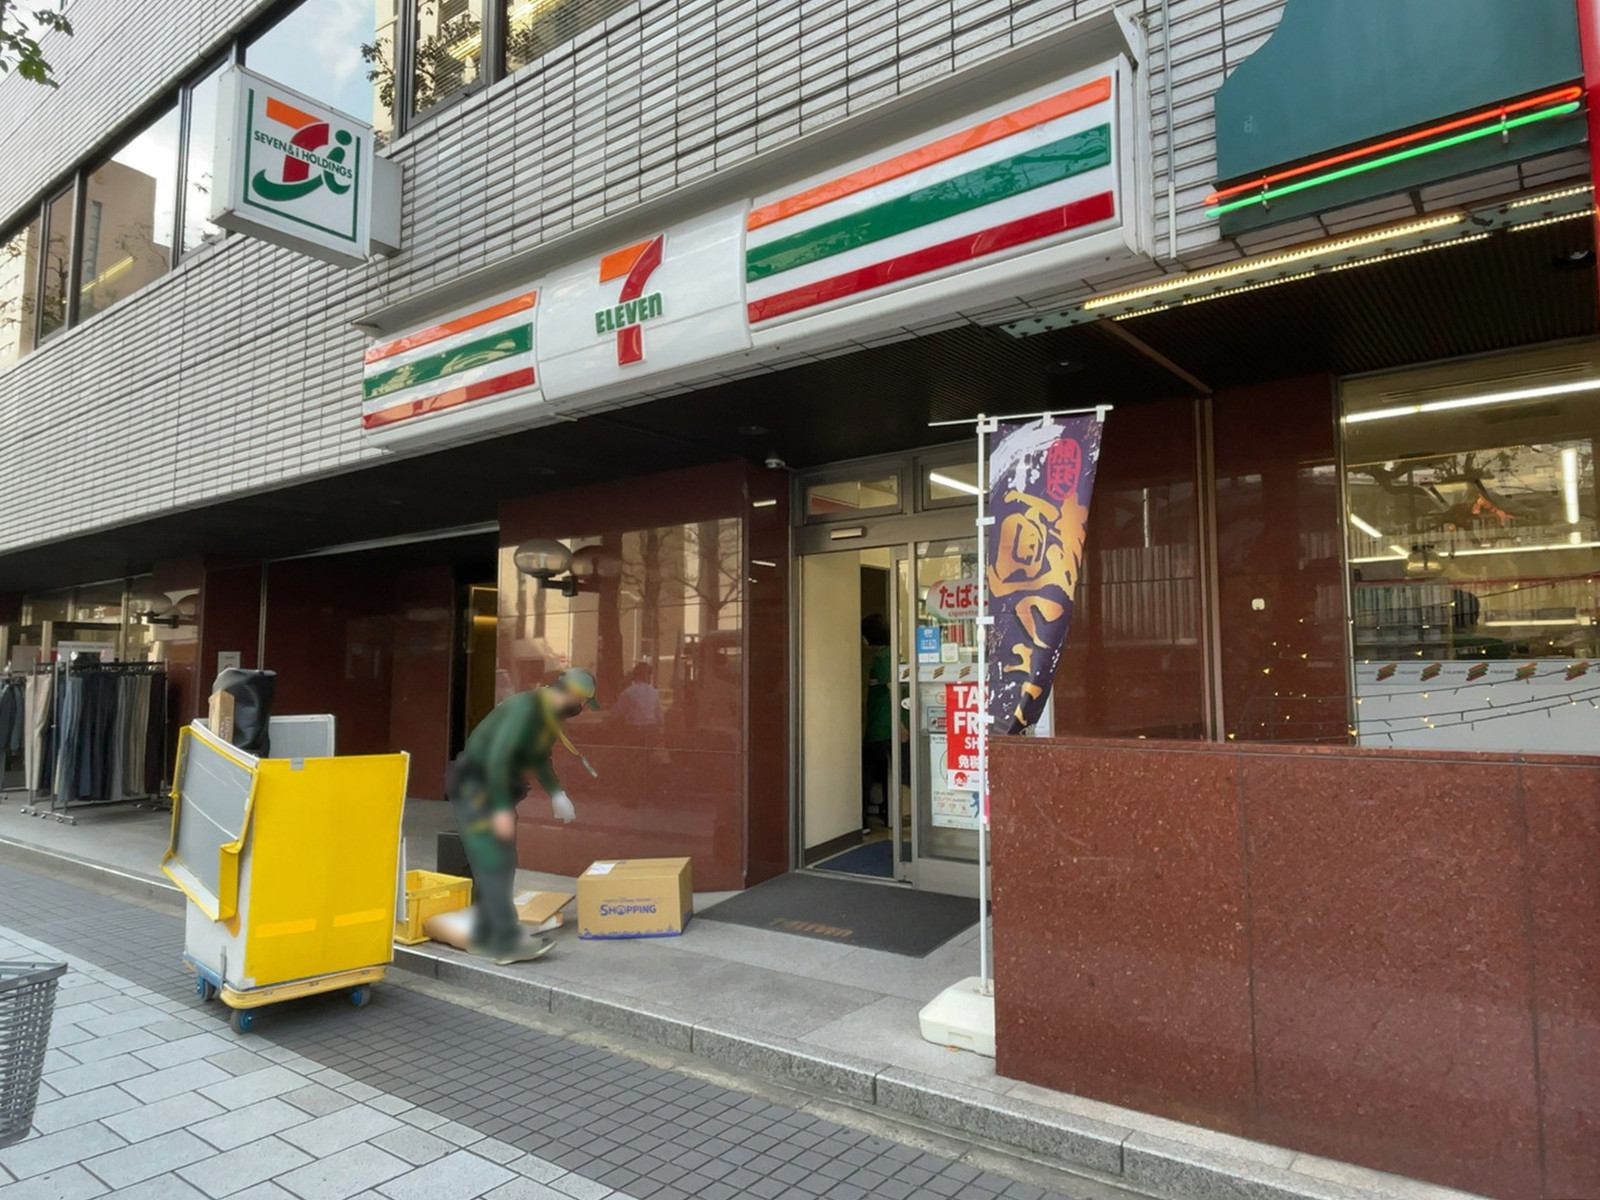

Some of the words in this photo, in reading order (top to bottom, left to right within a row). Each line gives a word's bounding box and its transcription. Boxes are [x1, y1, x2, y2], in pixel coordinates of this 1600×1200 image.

[301, 150, 353, 179] HOLDINGS
[599, 233, 664, 366] 7
[939, 583, 989, 609] たばこ
[953, 685, 988, 709] TA
[600, 904, 657, 916] SHOPPING
